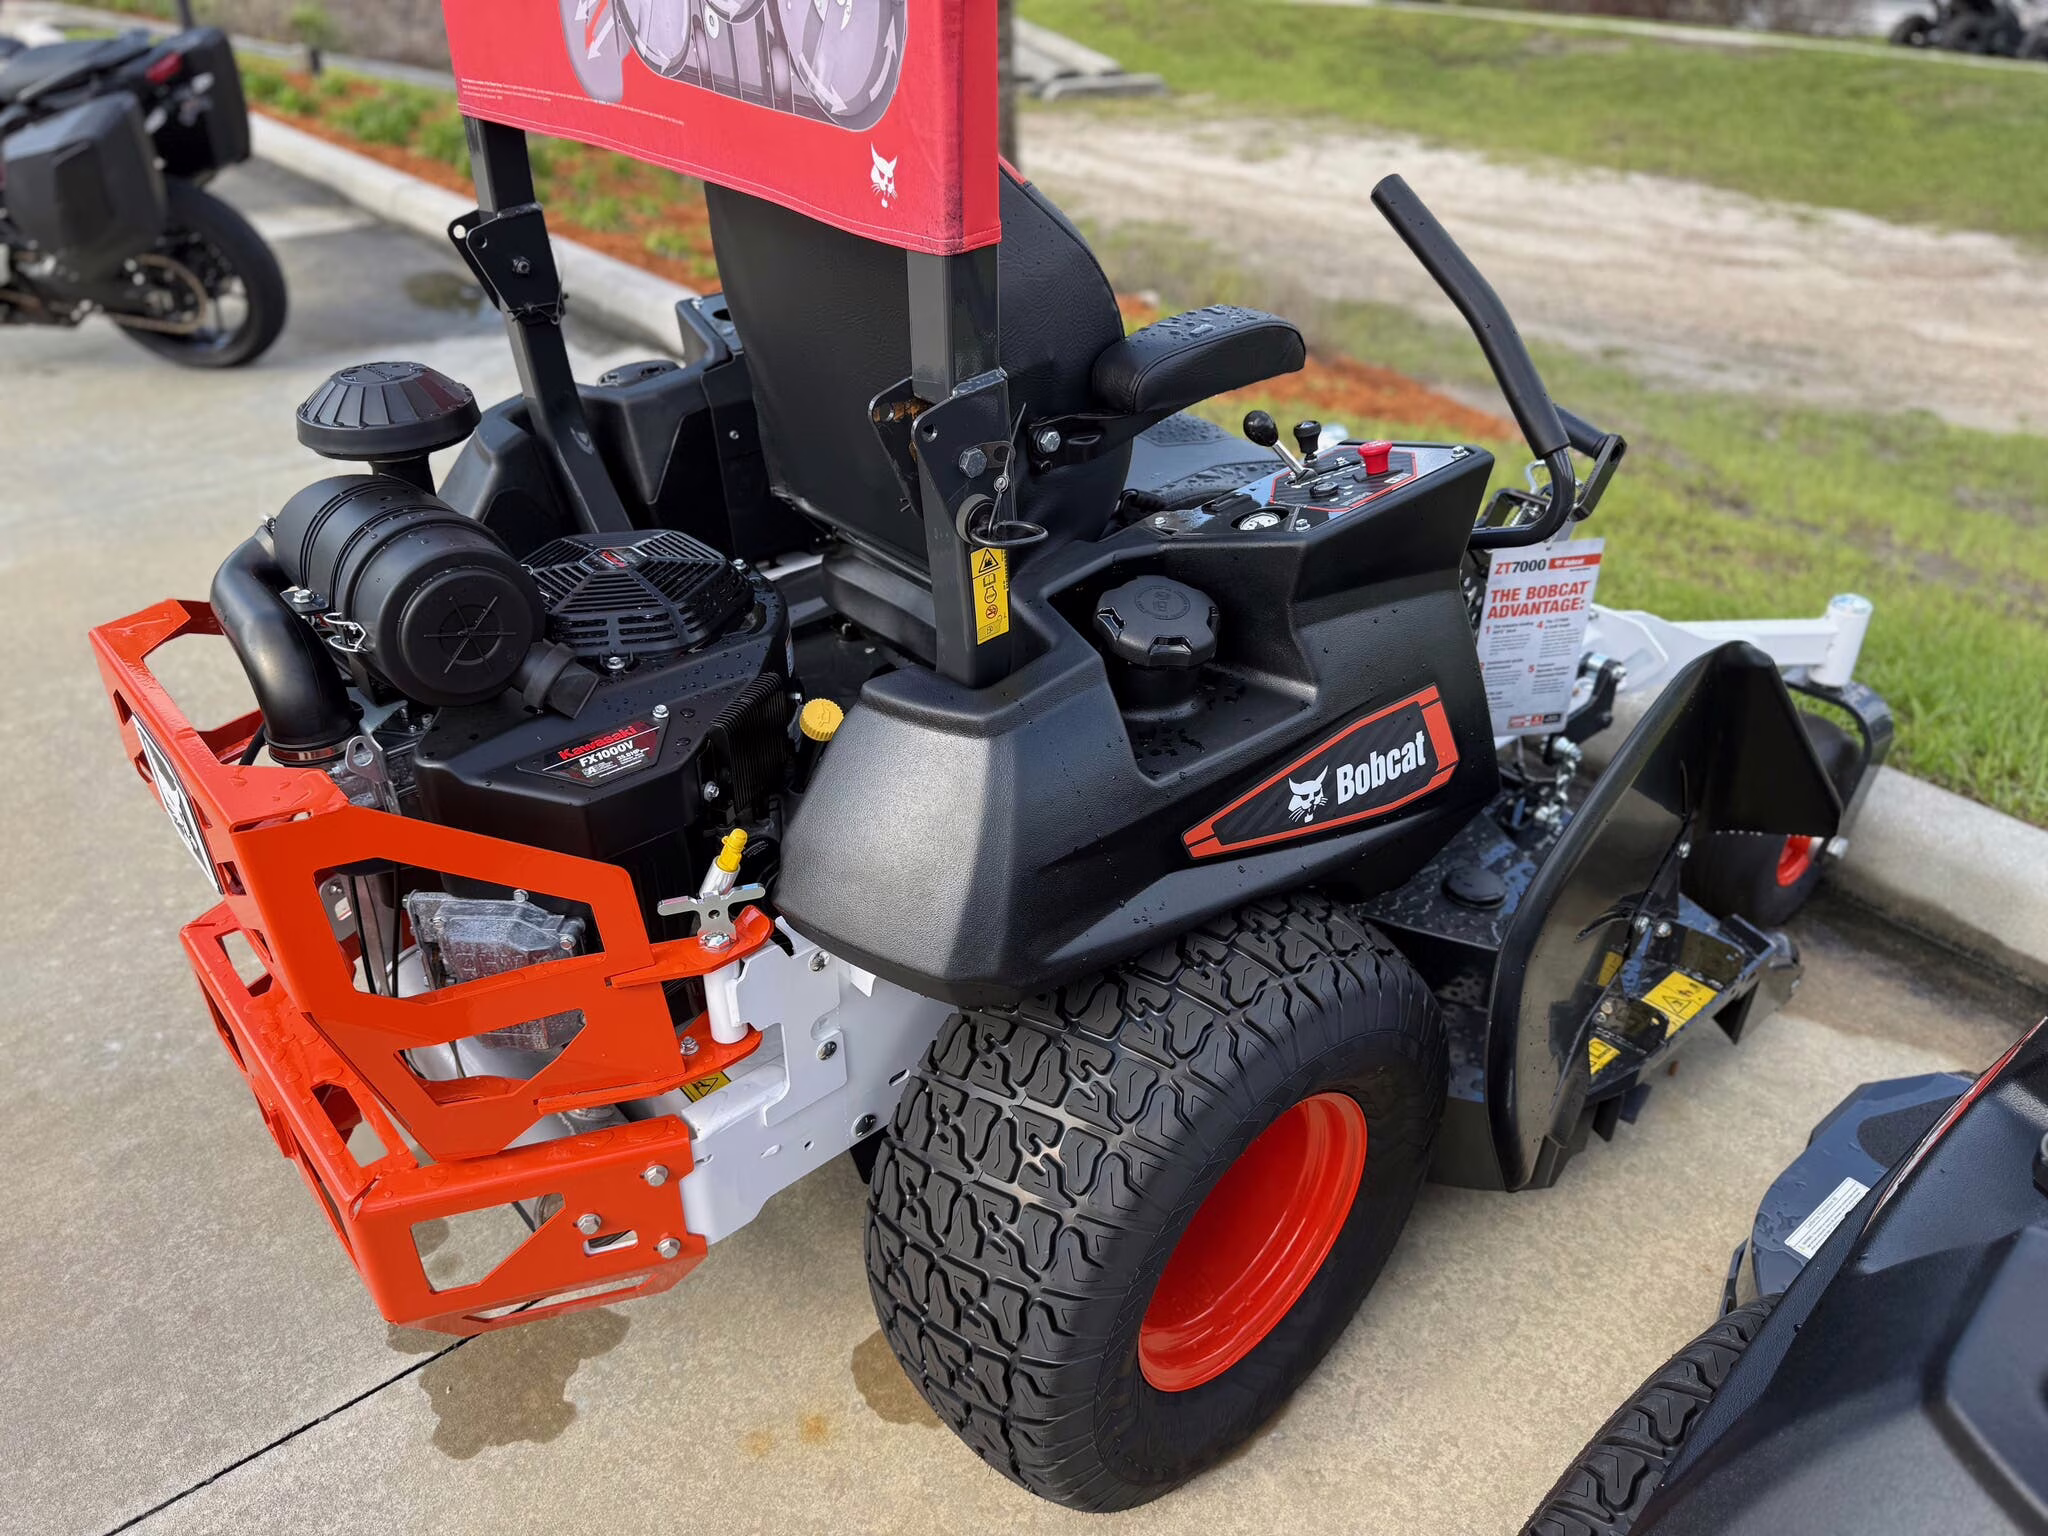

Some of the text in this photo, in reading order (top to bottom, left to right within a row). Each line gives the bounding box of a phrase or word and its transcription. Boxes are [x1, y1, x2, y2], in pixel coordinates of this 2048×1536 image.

[1494, 558, 1547, 575] ZT7000
[1490, 580, 1591, 604] THE BOBCAT
[1487, 597, 1585, 620] ADVANTAGE:
[558, 726, 637, 760] Kawasaki
[578, 739, 634, 768] FX1000V
[1335, 729, 1427, 805] Bobcat
